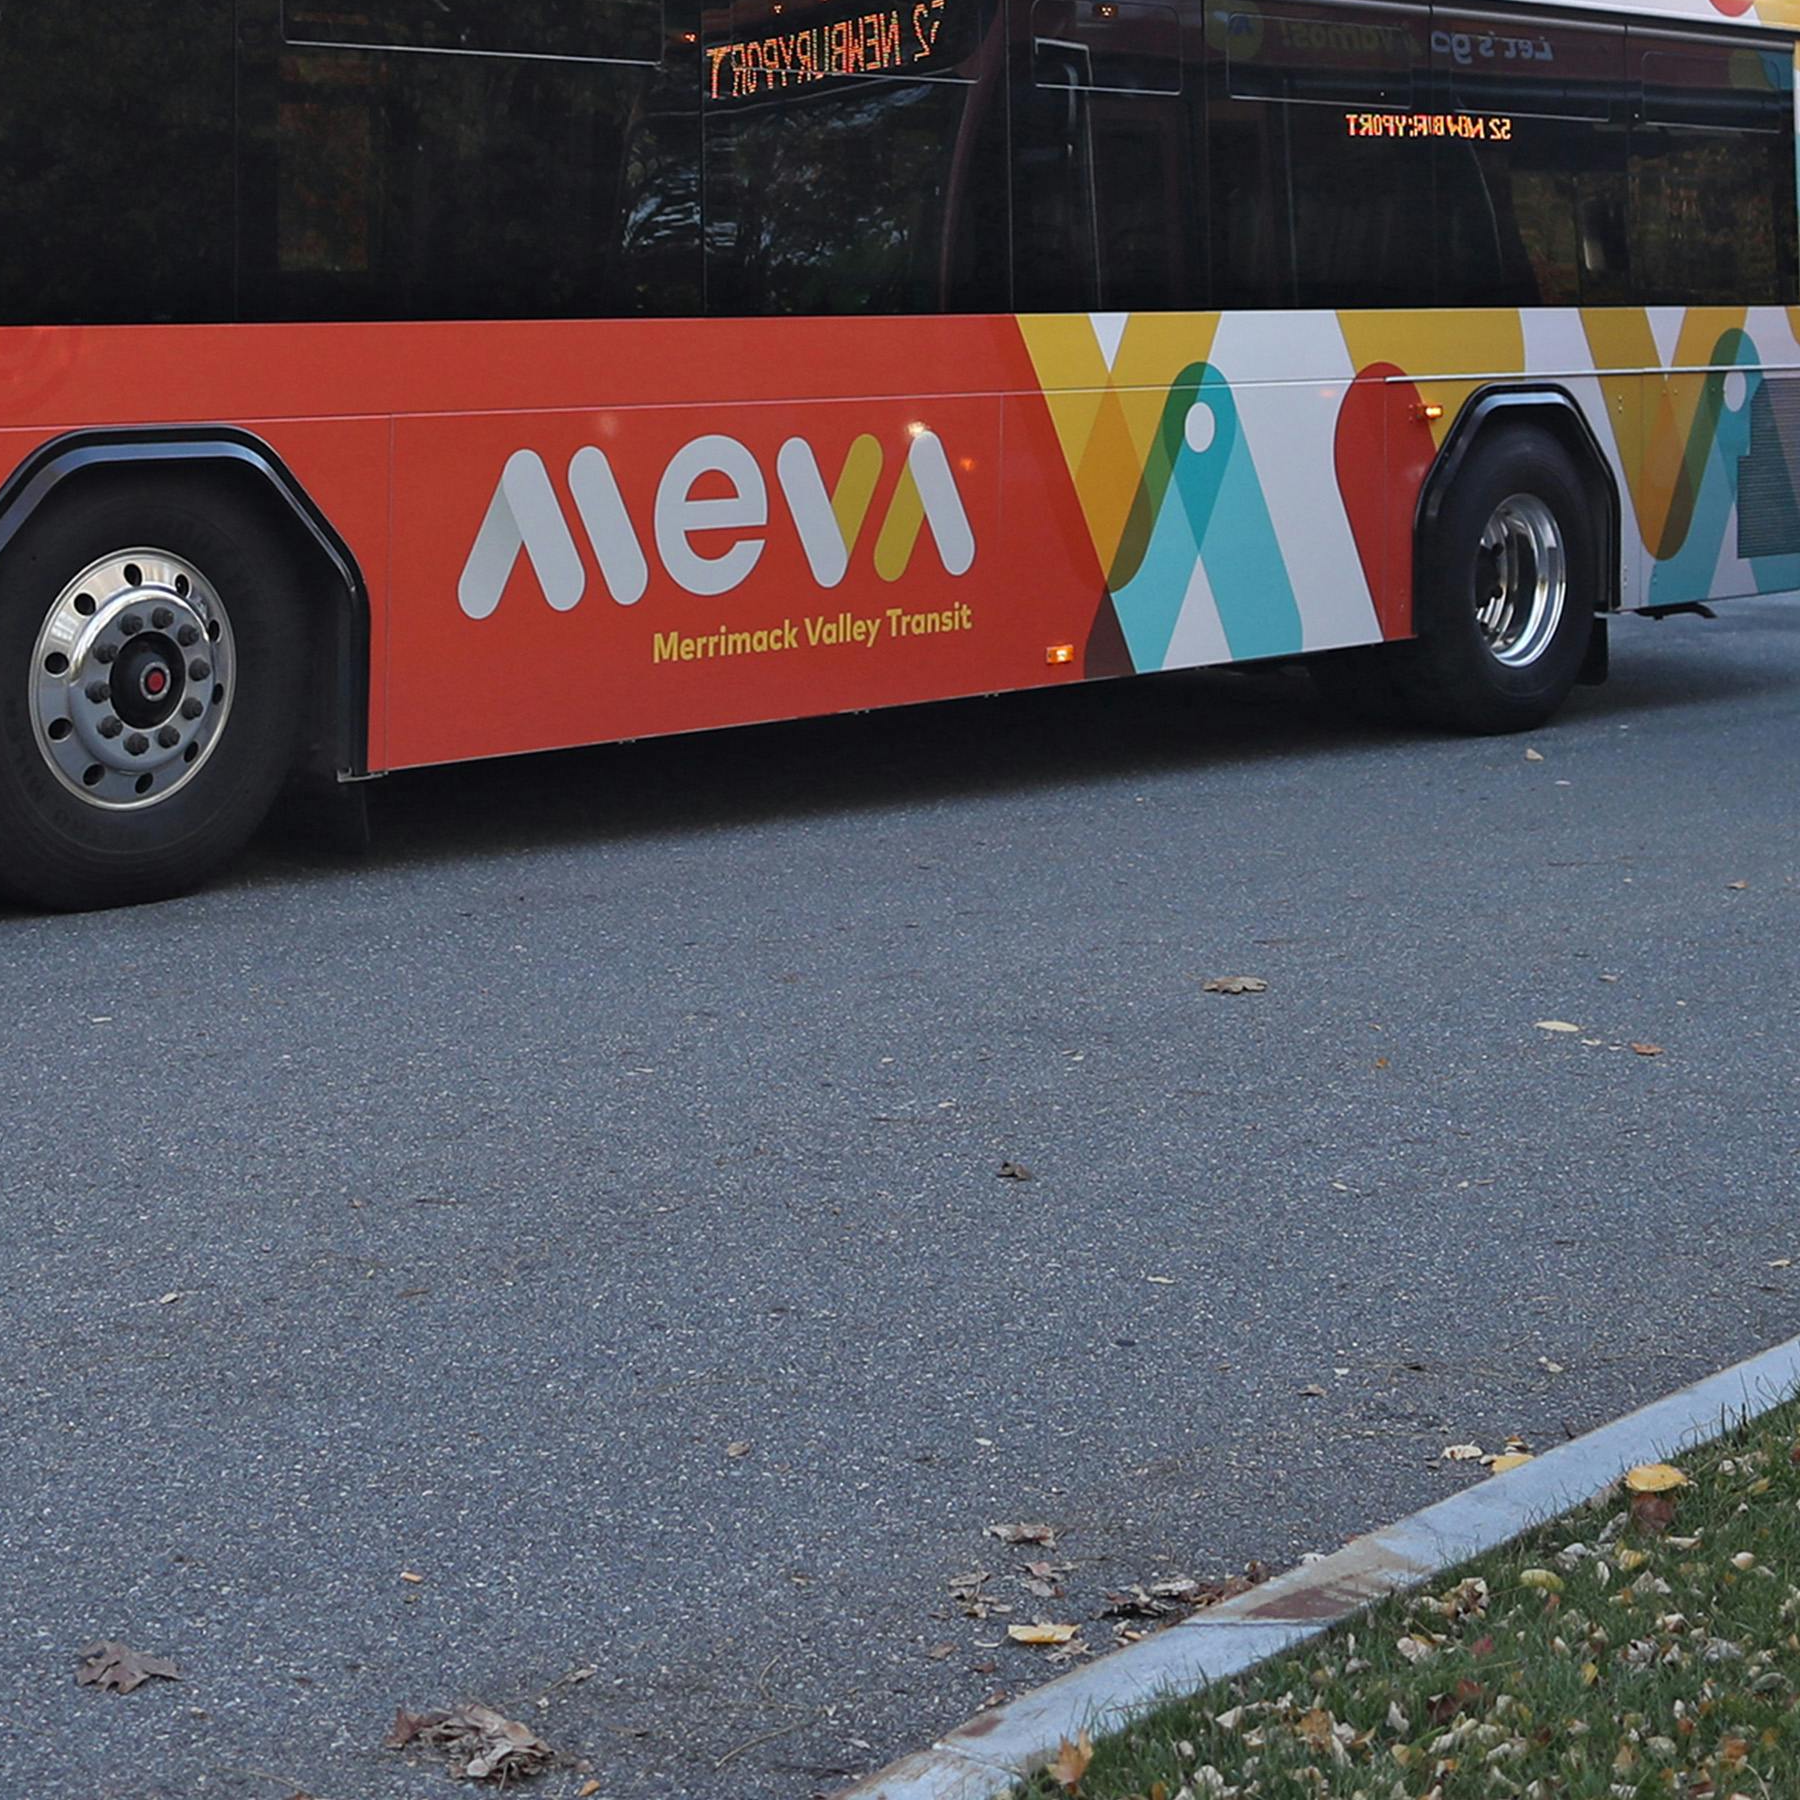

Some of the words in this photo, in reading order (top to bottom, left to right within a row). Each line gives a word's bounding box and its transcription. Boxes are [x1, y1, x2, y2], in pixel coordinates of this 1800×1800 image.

[653, 619, 799, 664] Merrimack
[804, 612, 881, 649] Valley
[886, 602, 973, 638] Transit
